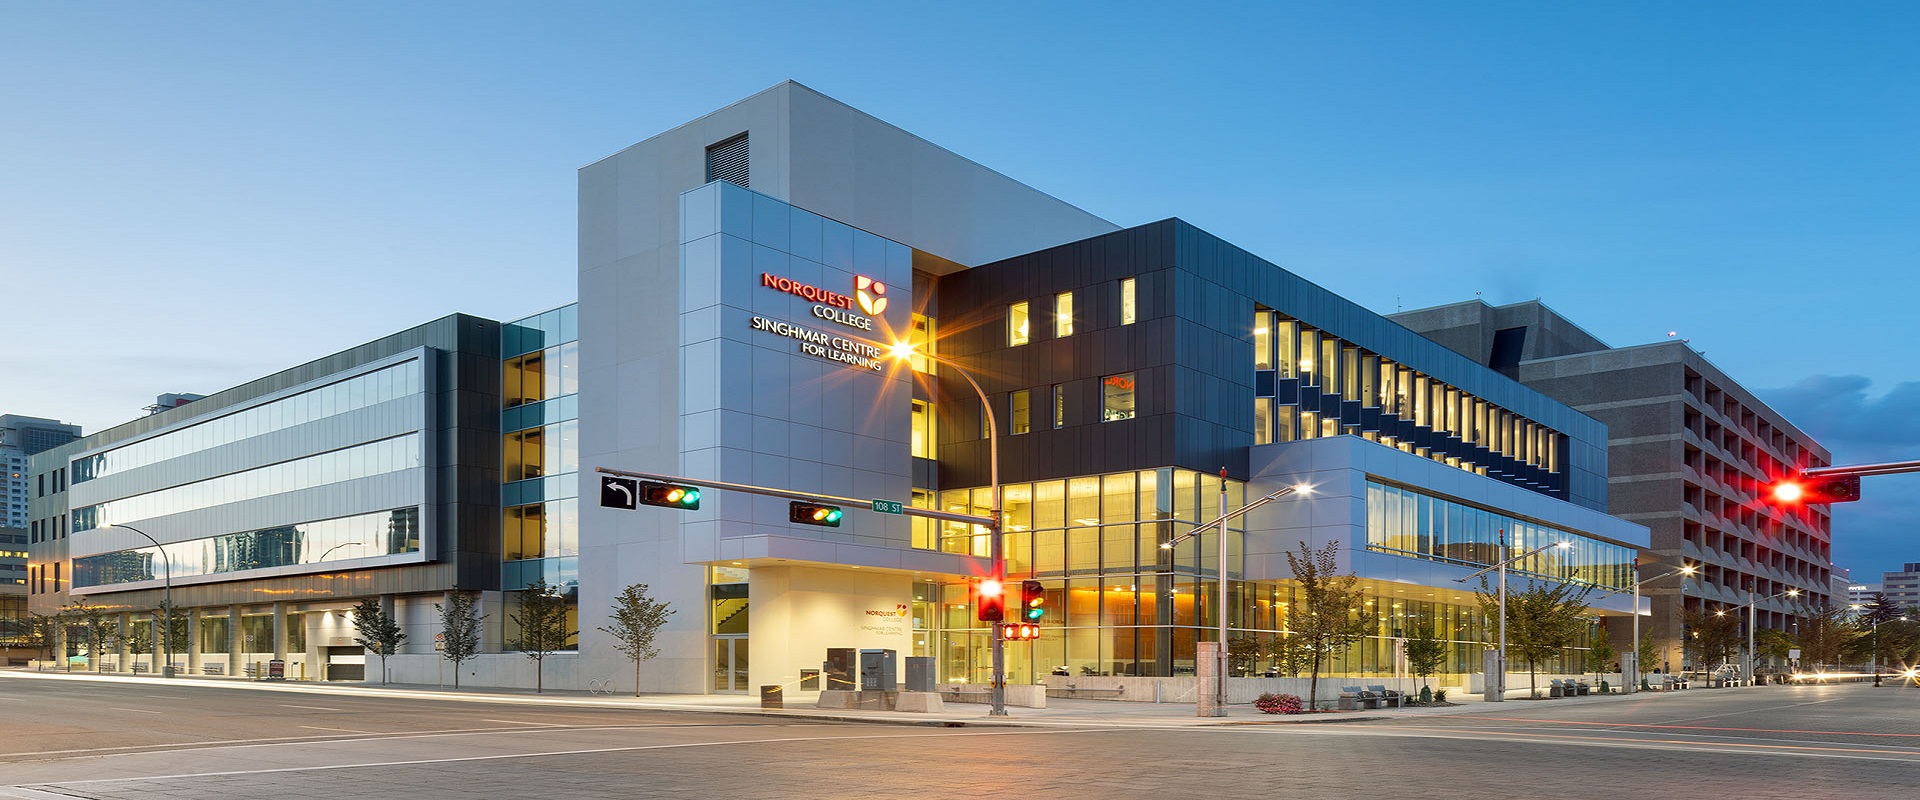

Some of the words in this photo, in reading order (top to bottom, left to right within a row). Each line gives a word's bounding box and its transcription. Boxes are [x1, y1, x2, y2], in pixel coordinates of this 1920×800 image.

[762, 272, 854, 310] NORQUEST
[812, 304, 872, 331] COLLEGE
[751, 316, 829, 346] SINGHMAR
[832, 337, 881, 360] CENTRE
[801, 342, 825, 358] FOR
[828, 350, 882, 371] LEARNING
[875, 501, 888, 511] 108
[892, 503, 900, 512] ST
